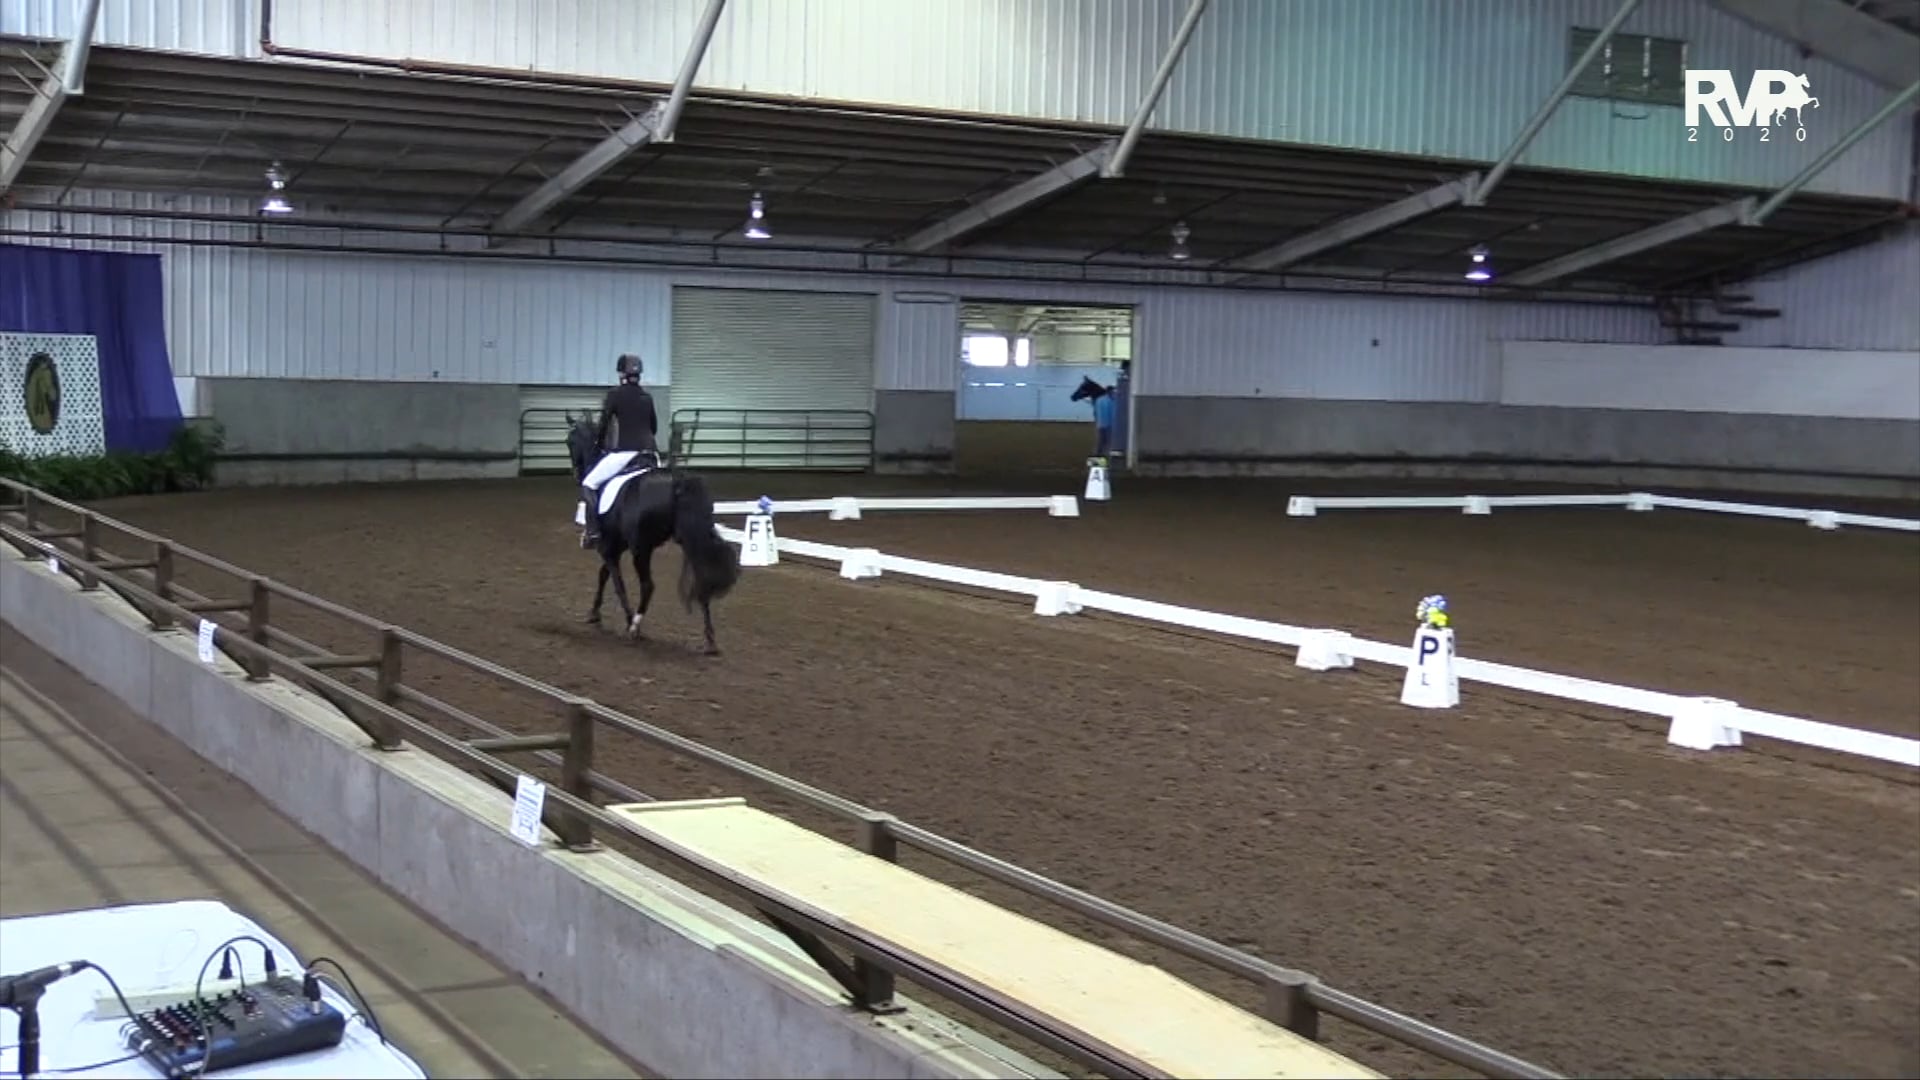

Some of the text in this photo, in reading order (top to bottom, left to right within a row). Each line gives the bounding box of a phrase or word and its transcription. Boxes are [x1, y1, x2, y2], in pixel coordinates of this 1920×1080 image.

[1091, 470, 1102, 482] A
[749, 521, 760, 540] F
[1418, 635, 1439, 666] P
